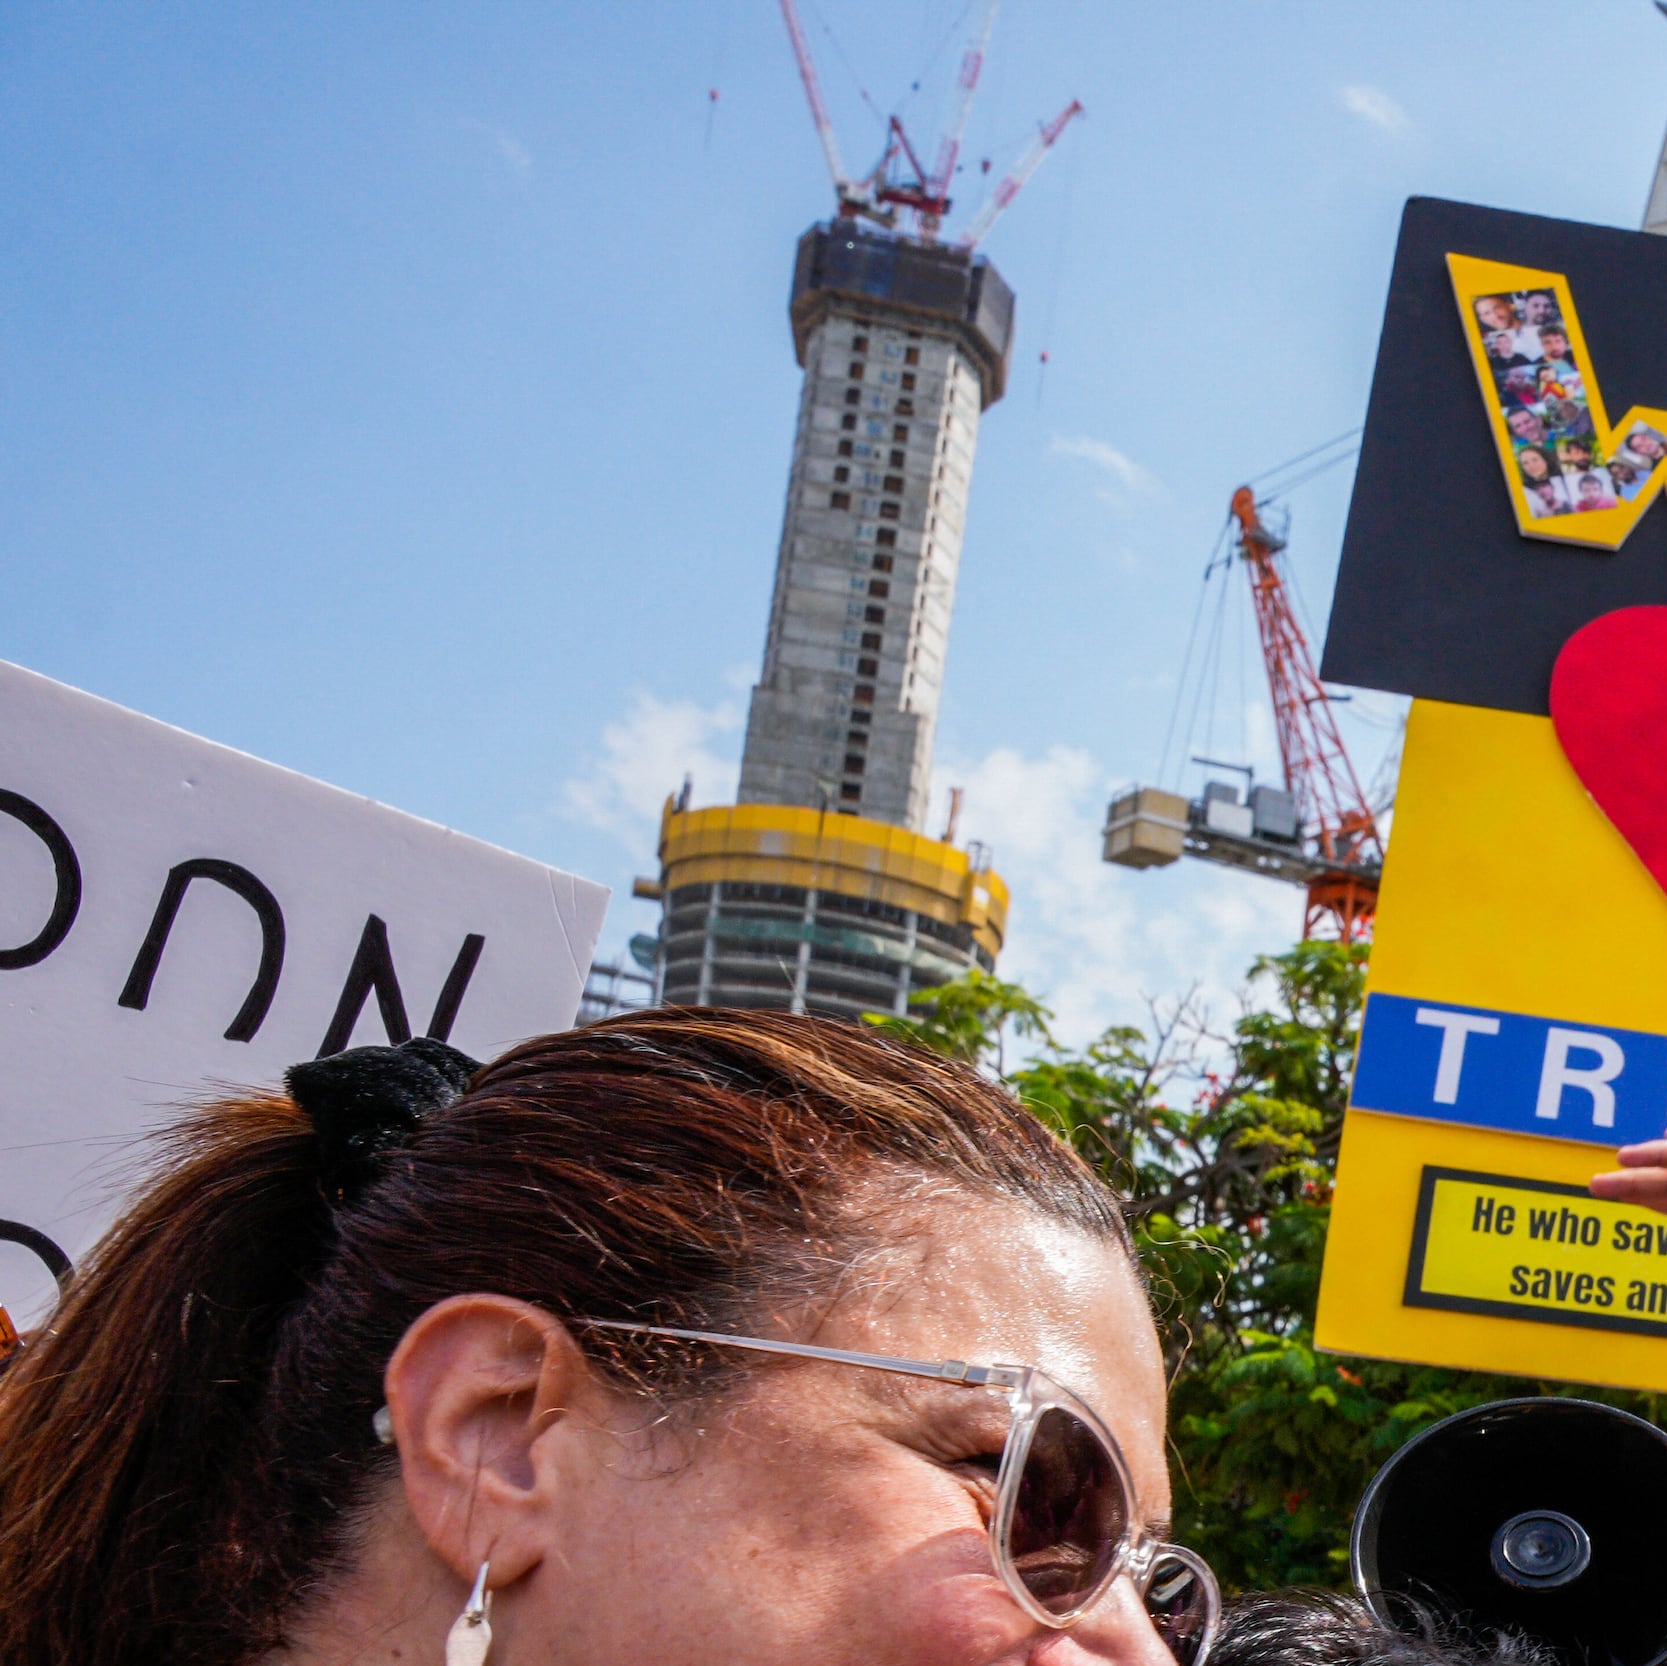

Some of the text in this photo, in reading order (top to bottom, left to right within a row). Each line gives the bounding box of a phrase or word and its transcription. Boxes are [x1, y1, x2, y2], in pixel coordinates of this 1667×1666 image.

[1472, 1196, 1516, 1236] He
[1528, 1207, 1601, 1247] who
[1509, 1264, 1614, 1307] saves
